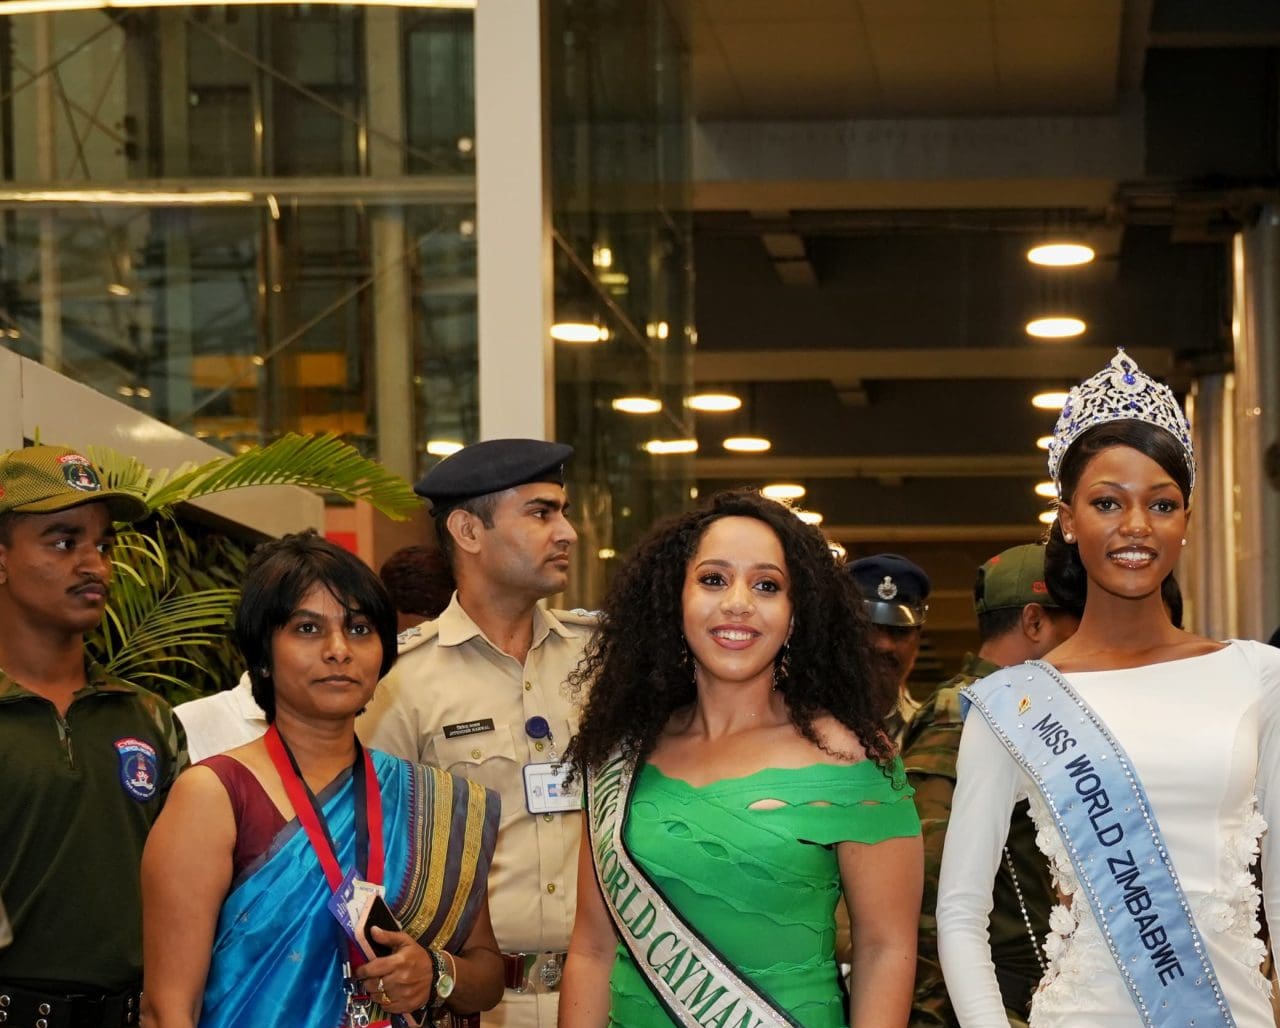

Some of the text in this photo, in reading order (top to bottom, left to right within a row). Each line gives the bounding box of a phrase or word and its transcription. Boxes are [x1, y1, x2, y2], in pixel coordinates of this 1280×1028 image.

[598, 820, 657, 940] WORLD
[1032, 713, 1184, 987] MISS WORLD ZIMBABWE
